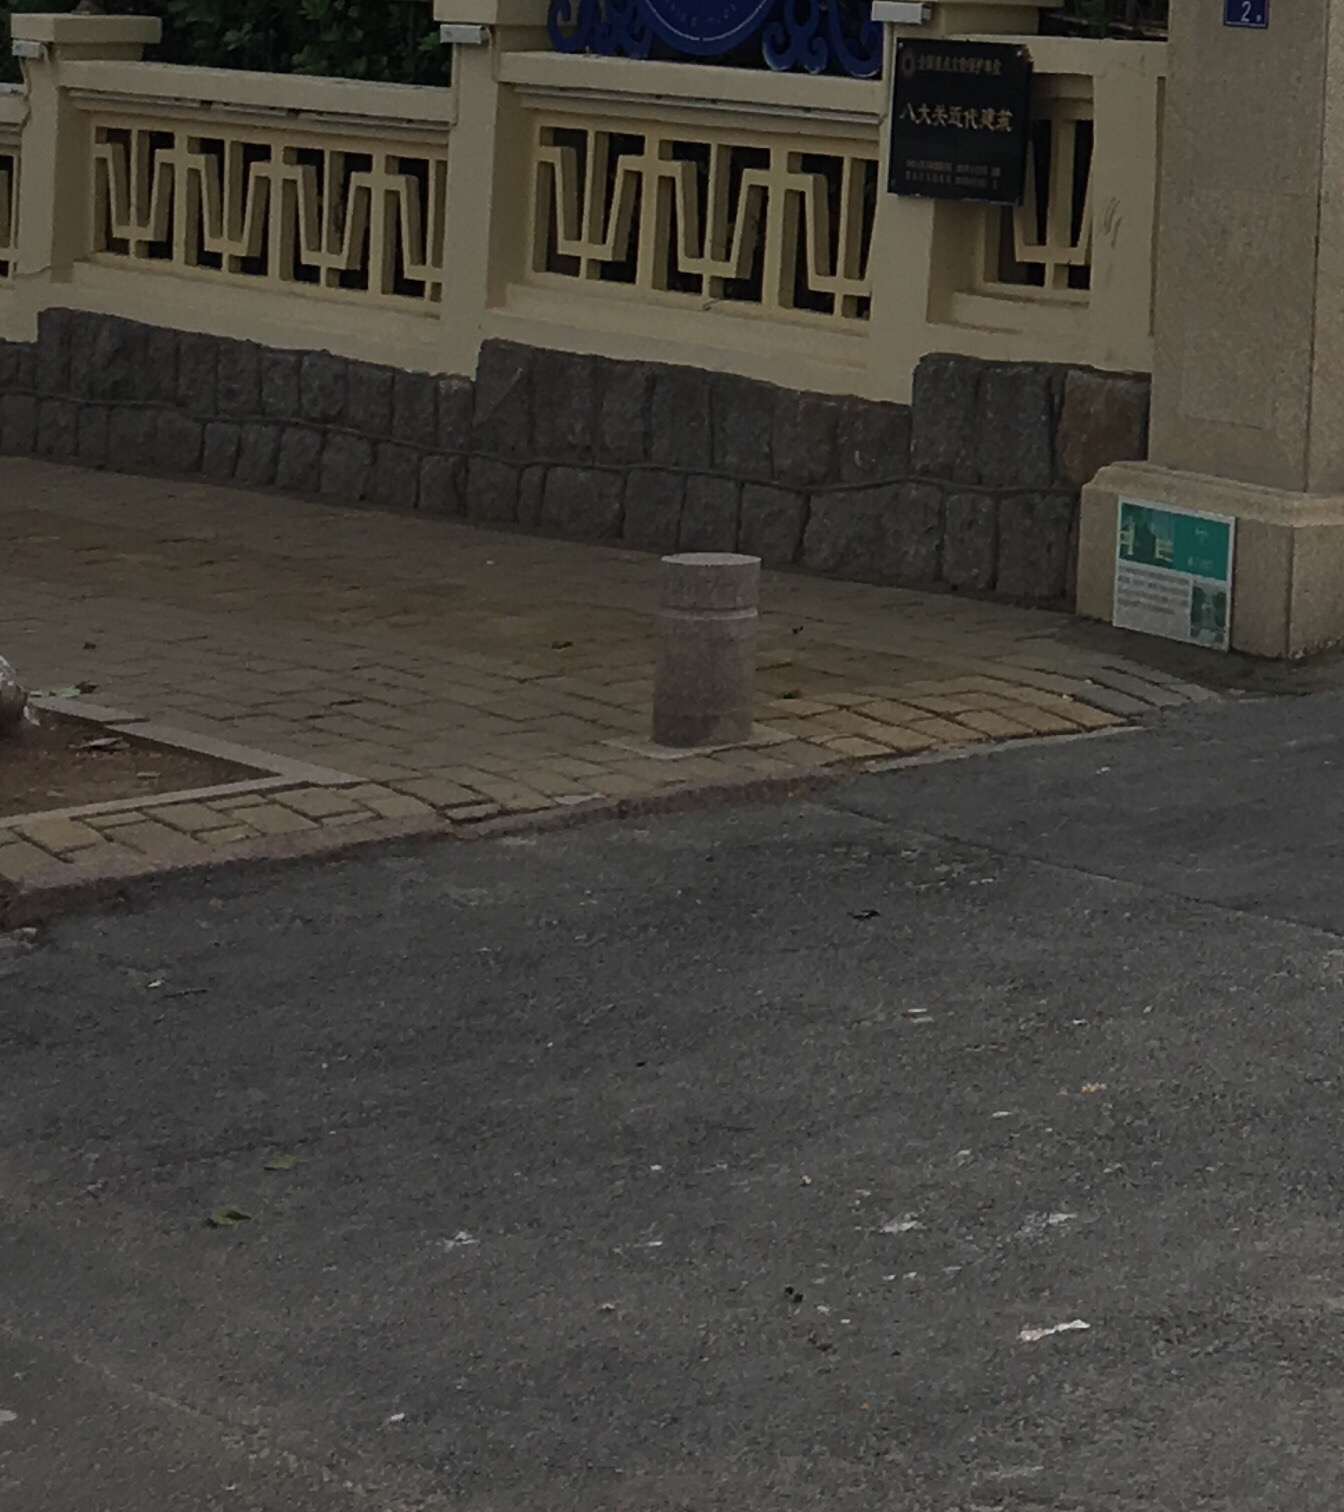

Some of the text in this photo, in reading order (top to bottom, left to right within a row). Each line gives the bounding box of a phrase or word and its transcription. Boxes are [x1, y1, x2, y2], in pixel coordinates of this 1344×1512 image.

[900, 103, 1013, 132] 八大关近代建筑
